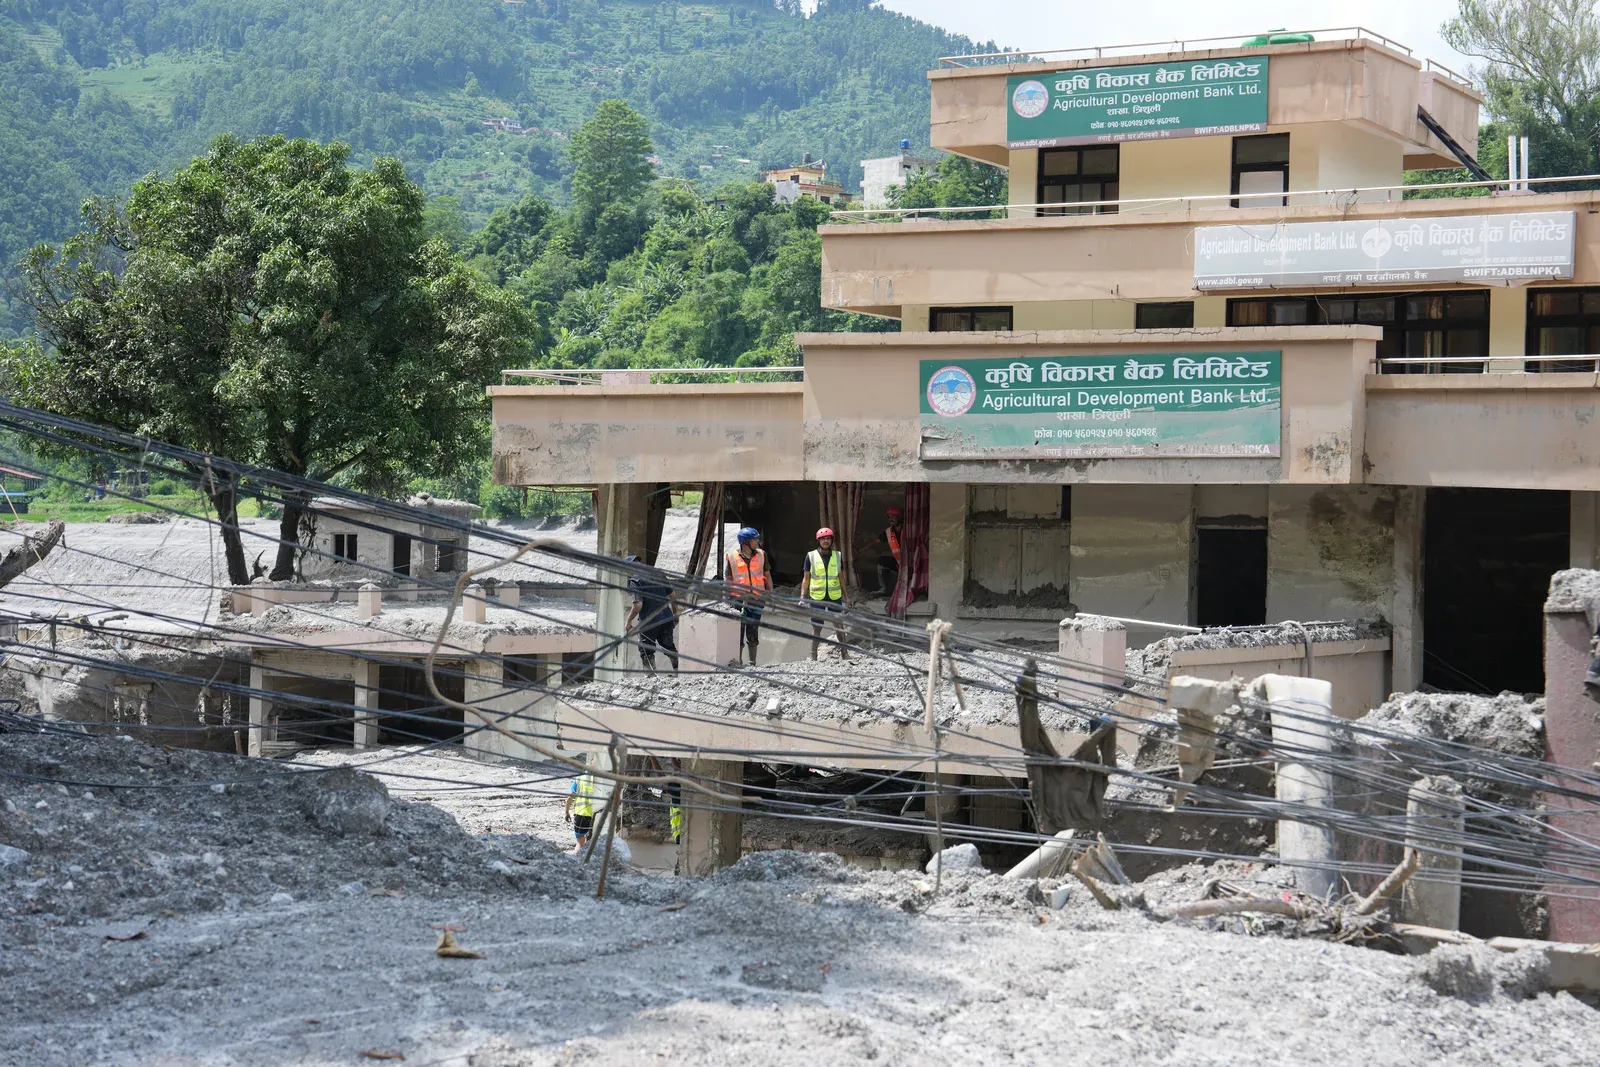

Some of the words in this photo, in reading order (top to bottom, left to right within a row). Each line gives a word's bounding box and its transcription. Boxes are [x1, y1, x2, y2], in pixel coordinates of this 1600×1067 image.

[1054, 75, 1090, 94] कृषि
[1096, 72, 1150, 88] विकास
[1191, 62, 1262, 81] लिमिटेड
[1053, 92, 1118, 111] Agricultural
[1122, 88, 1199, 105] Development
[1204, 85, 1234, 98] Bank
[1239, 83, 1262, 95] Ltd.
[1194, 124, 1261, 136] SWIFT:ADBLNPKA
[1009, 139, 1057, 148] www.adbl.gov.np
[1200, 236, 1251, 259] Agricultural
[1315, 232, 1337, 250] Bank
[1340, 230, 1357, 249] Ltd.
[1394, 223, 1424, 251] कृषि
[1429, 223, 1475, 245] विकास
[1509, 219, 1568, 243] लिमिटेड
[1198, 277, 1263, 286] www.adbl.gov.np
[1463, 266, 1562, 278] SWIFT:ADBLNPKA
[984, 362, 1034, 388] कृषि
[1041, 361, 1116, 382] विकास
[1173, 356, 1272, 380] लिमिटेड
[982, 392, 1071, 411] Agricultural
[1078, 389, 1184, 407] Development
[1191, 388, 1233, 403] Bank
[1240, 388, 1272, 403] Ltd.
